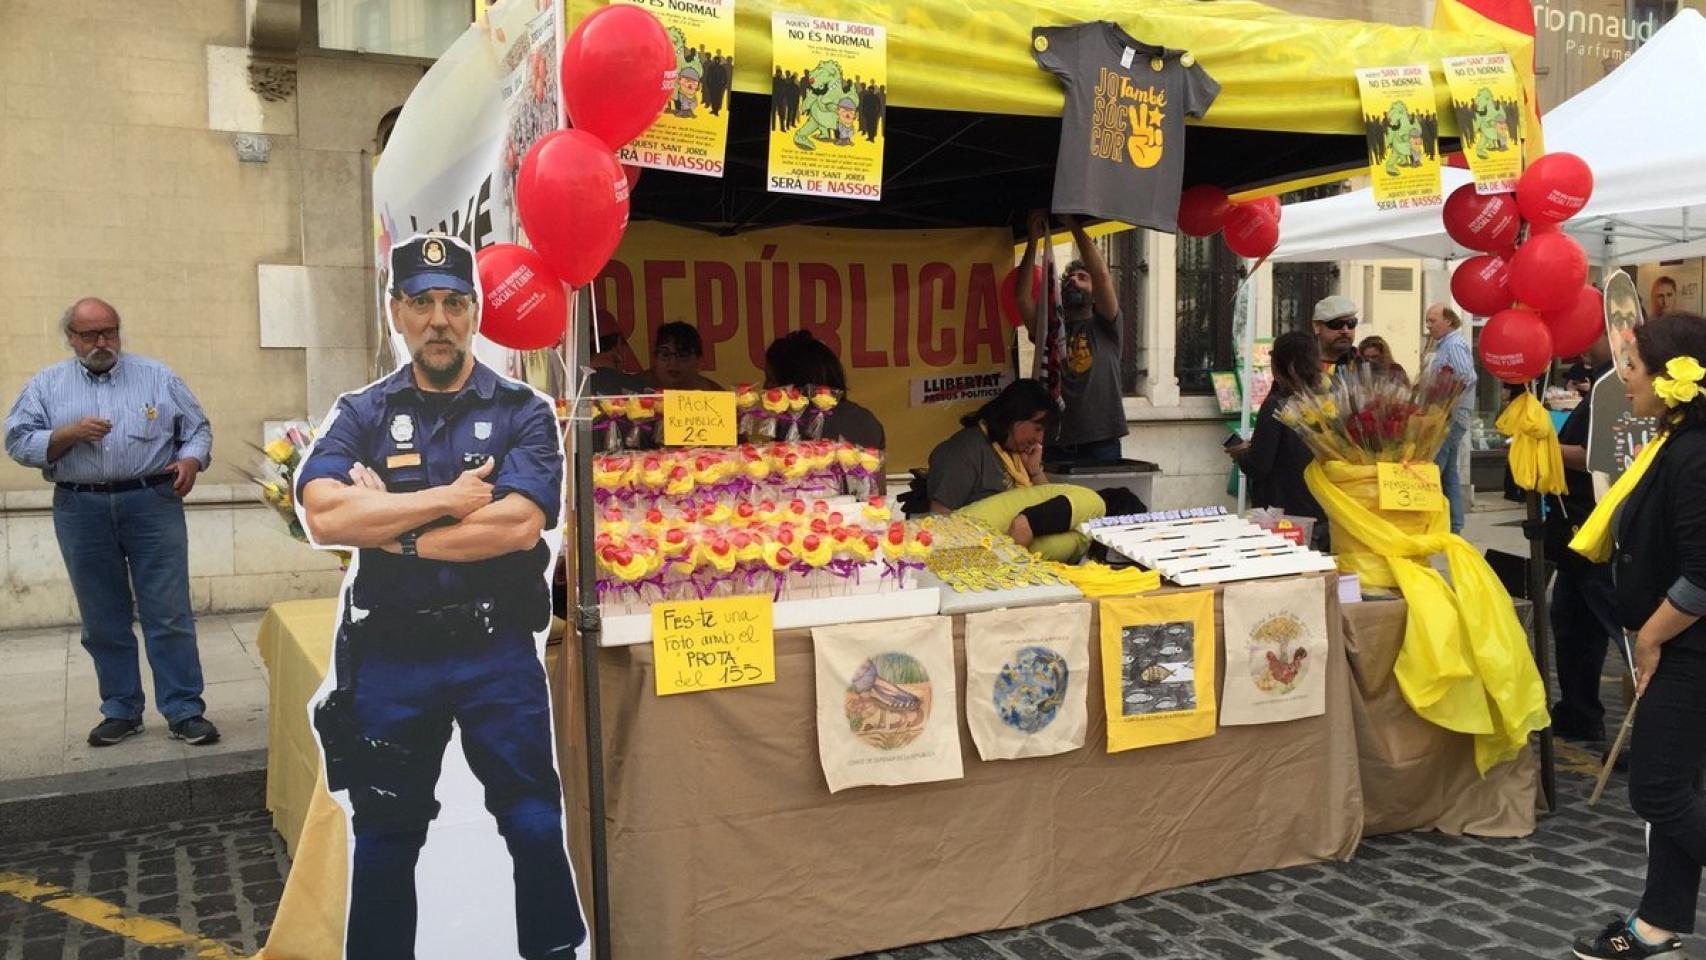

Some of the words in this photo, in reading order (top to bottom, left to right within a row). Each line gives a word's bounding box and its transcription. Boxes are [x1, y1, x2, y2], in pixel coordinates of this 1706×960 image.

[668, 0, 720, 18] NORMAL
[812, 19, 840, 31] SANT
[845, 24, 875, 36] JORDI
[788, 29, 804, 40] NO
[826, 33, 873, 49] NORMAL
[1095, 67, 1120, 98] JO
[1120, 76, 1168, 107] També
[1368, 79, 1380, 88] NO
[1392, 76, 1424, 87] NORMAL
[660, 144, 682, 152] SANT
[1090, 126, 1126, 162] CDR
[643, 151, 661, 164] DE
[666, 154, 722, 173] NASSOS
[822, 171, 842, 180] SANT
[807, 180, 823, 192] DE
[827, 181, 880, 197] NASSOS
[1399, 199, 1409, 208] DE
[1411, 195, 1442, 207] NASSOS
[597, 243, 1006, 374] REPÚBLICA
[924, 372, 1001, 393] LLIBERTAT
[678, 394, 721, 417] PACK
[701, 630, 735, 647] amb
[1610, 935, 1630, 952] N
